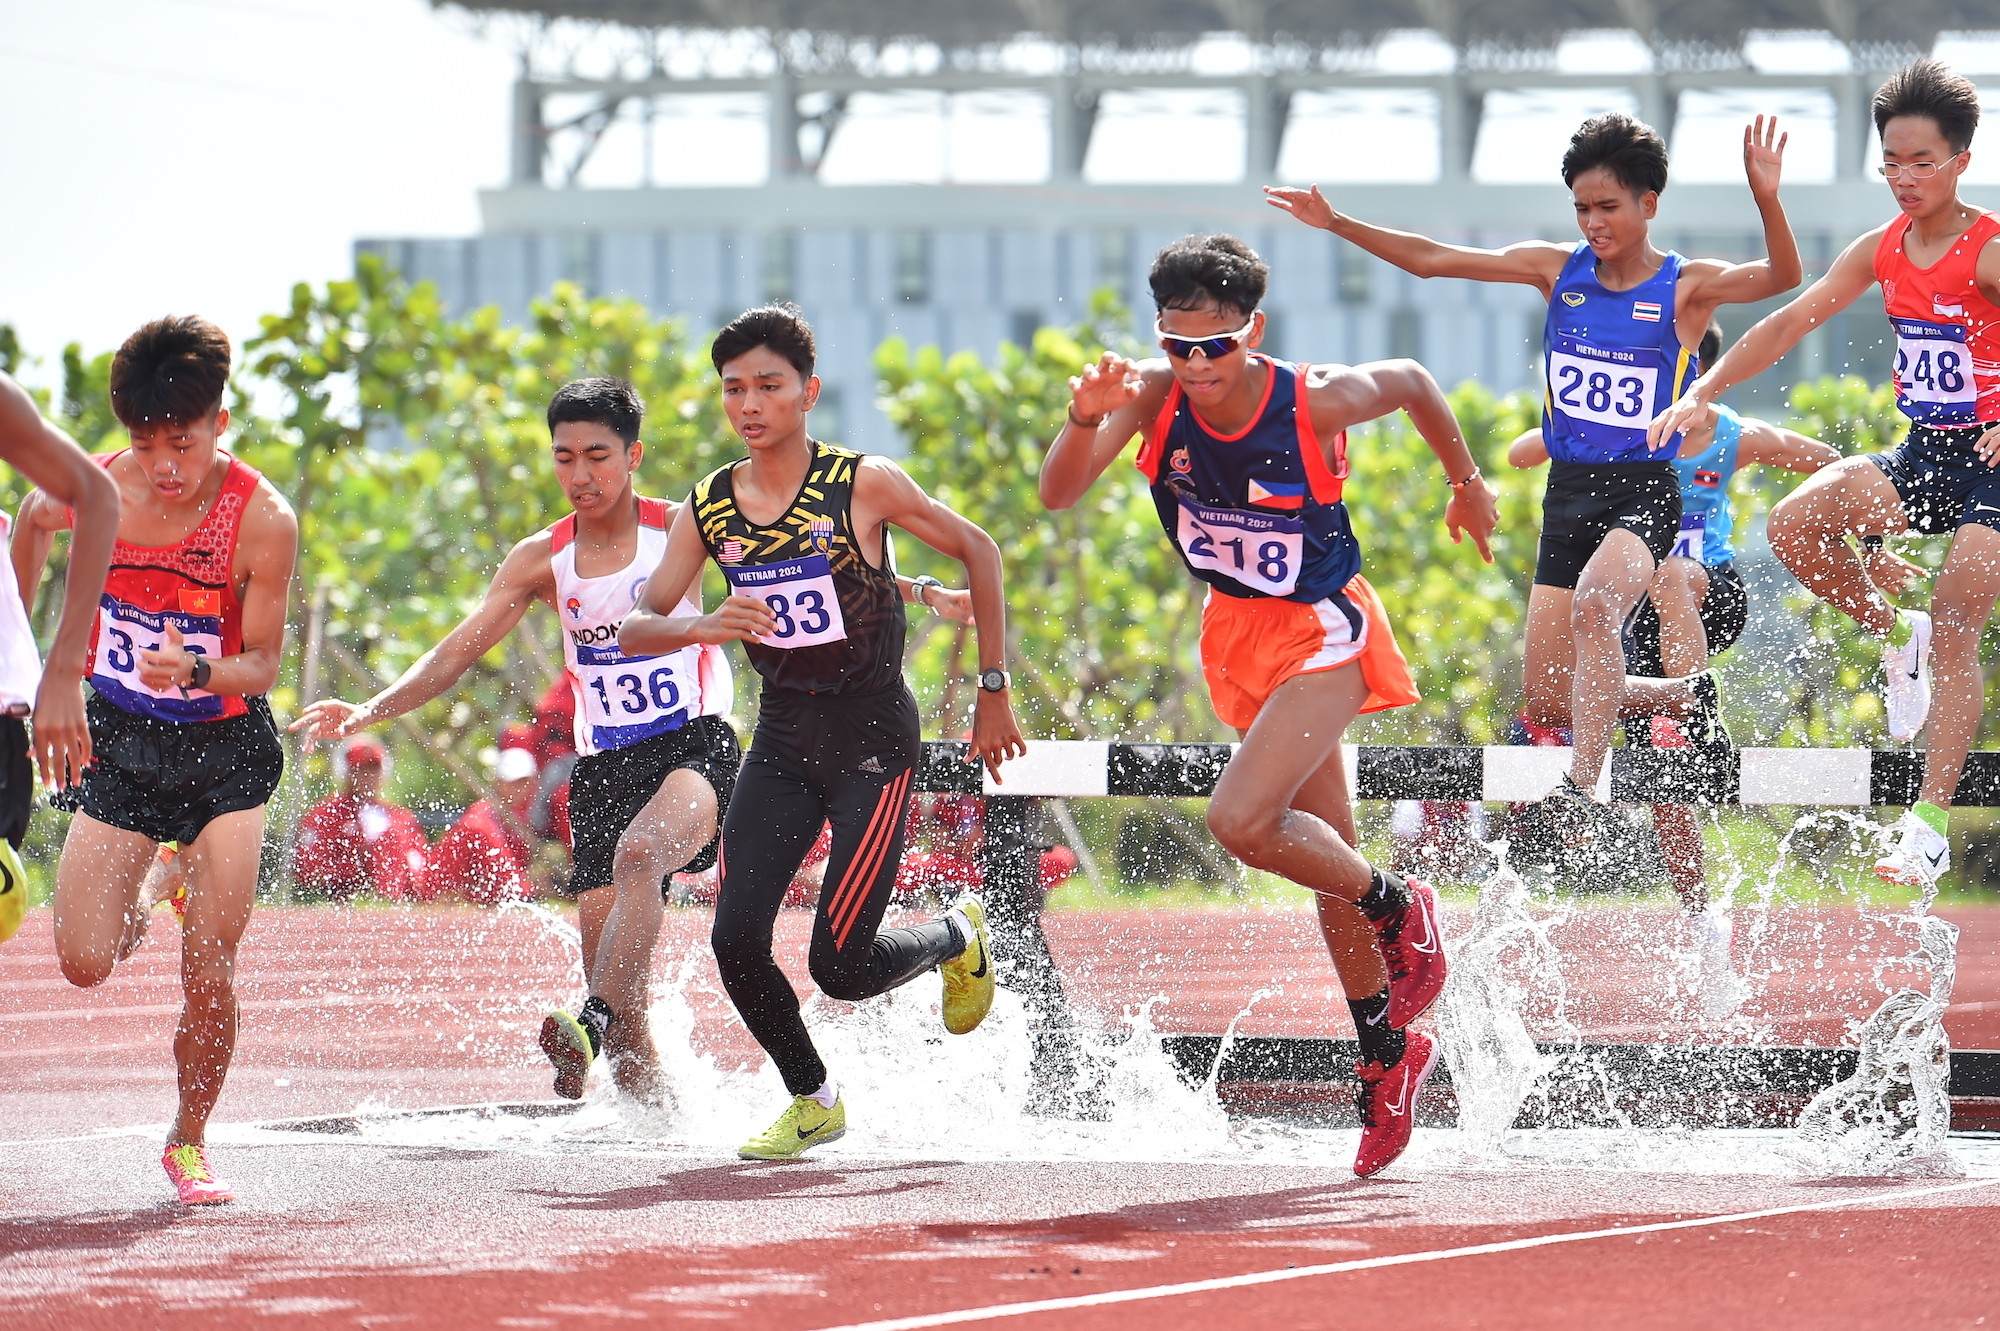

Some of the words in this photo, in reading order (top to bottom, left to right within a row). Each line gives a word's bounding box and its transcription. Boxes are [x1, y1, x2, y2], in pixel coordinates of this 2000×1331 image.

[1575, 343, 1610, 359] VIETNAM
[1612, 352, 1634, 361] 2024
[1558, 365, 1644, 417] 283
[1199, 511, 1245, 525] VIETNAM
[1247, 518, 1274, 529] 2024
[1188, 521, 1288, 584] 218
[738, 570, 777, 581] VIETNAM
[778, 565, 803, 577] 2024
[746, 590, 831, 638] 83
[569, 621, 622, 645] INDON
[593, 651, 627, 661] VIETNA
[590, 667, 680, 716] 136
